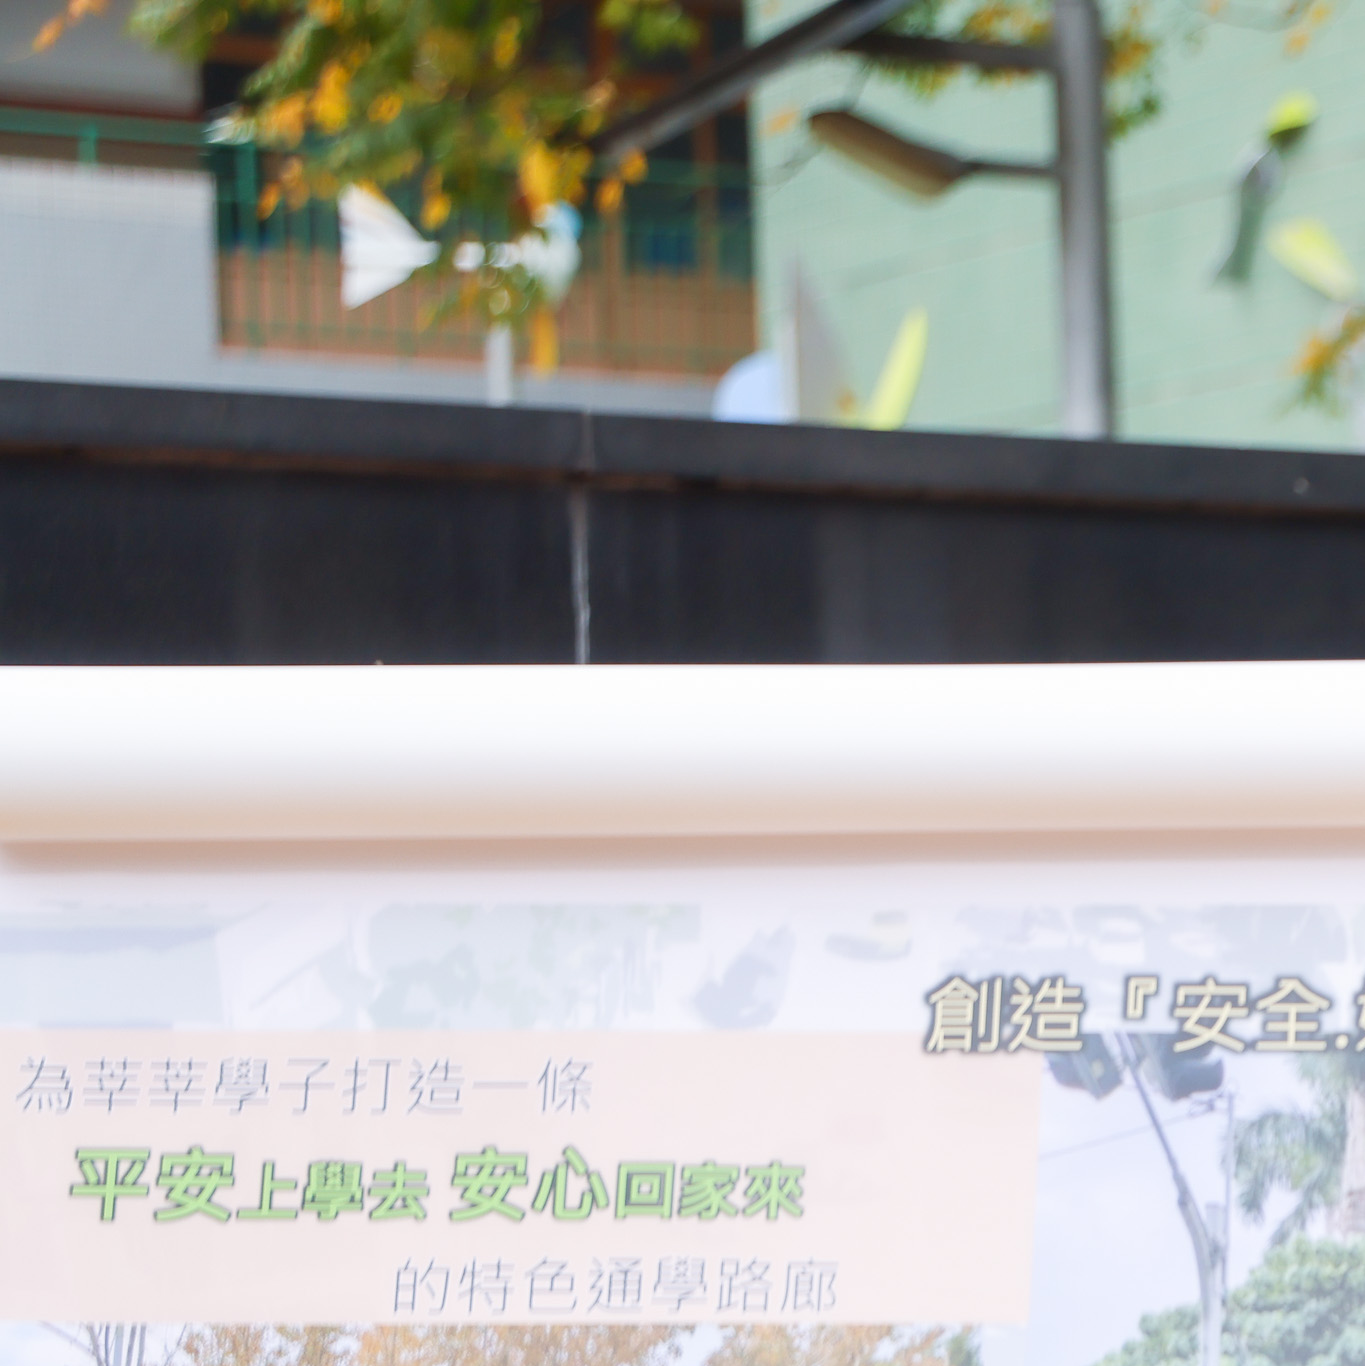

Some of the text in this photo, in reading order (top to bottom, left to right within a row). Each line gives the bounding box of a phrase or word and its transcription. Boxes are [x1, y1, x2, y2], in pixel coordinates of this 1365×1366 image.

[13, 1056, 596, 1117] 為莘莘學子打造一條
[69, 1145, 806, 1224] 平安上學去 安心回家來
[391, 1256, 840, 1316] 的特色通學路廊
